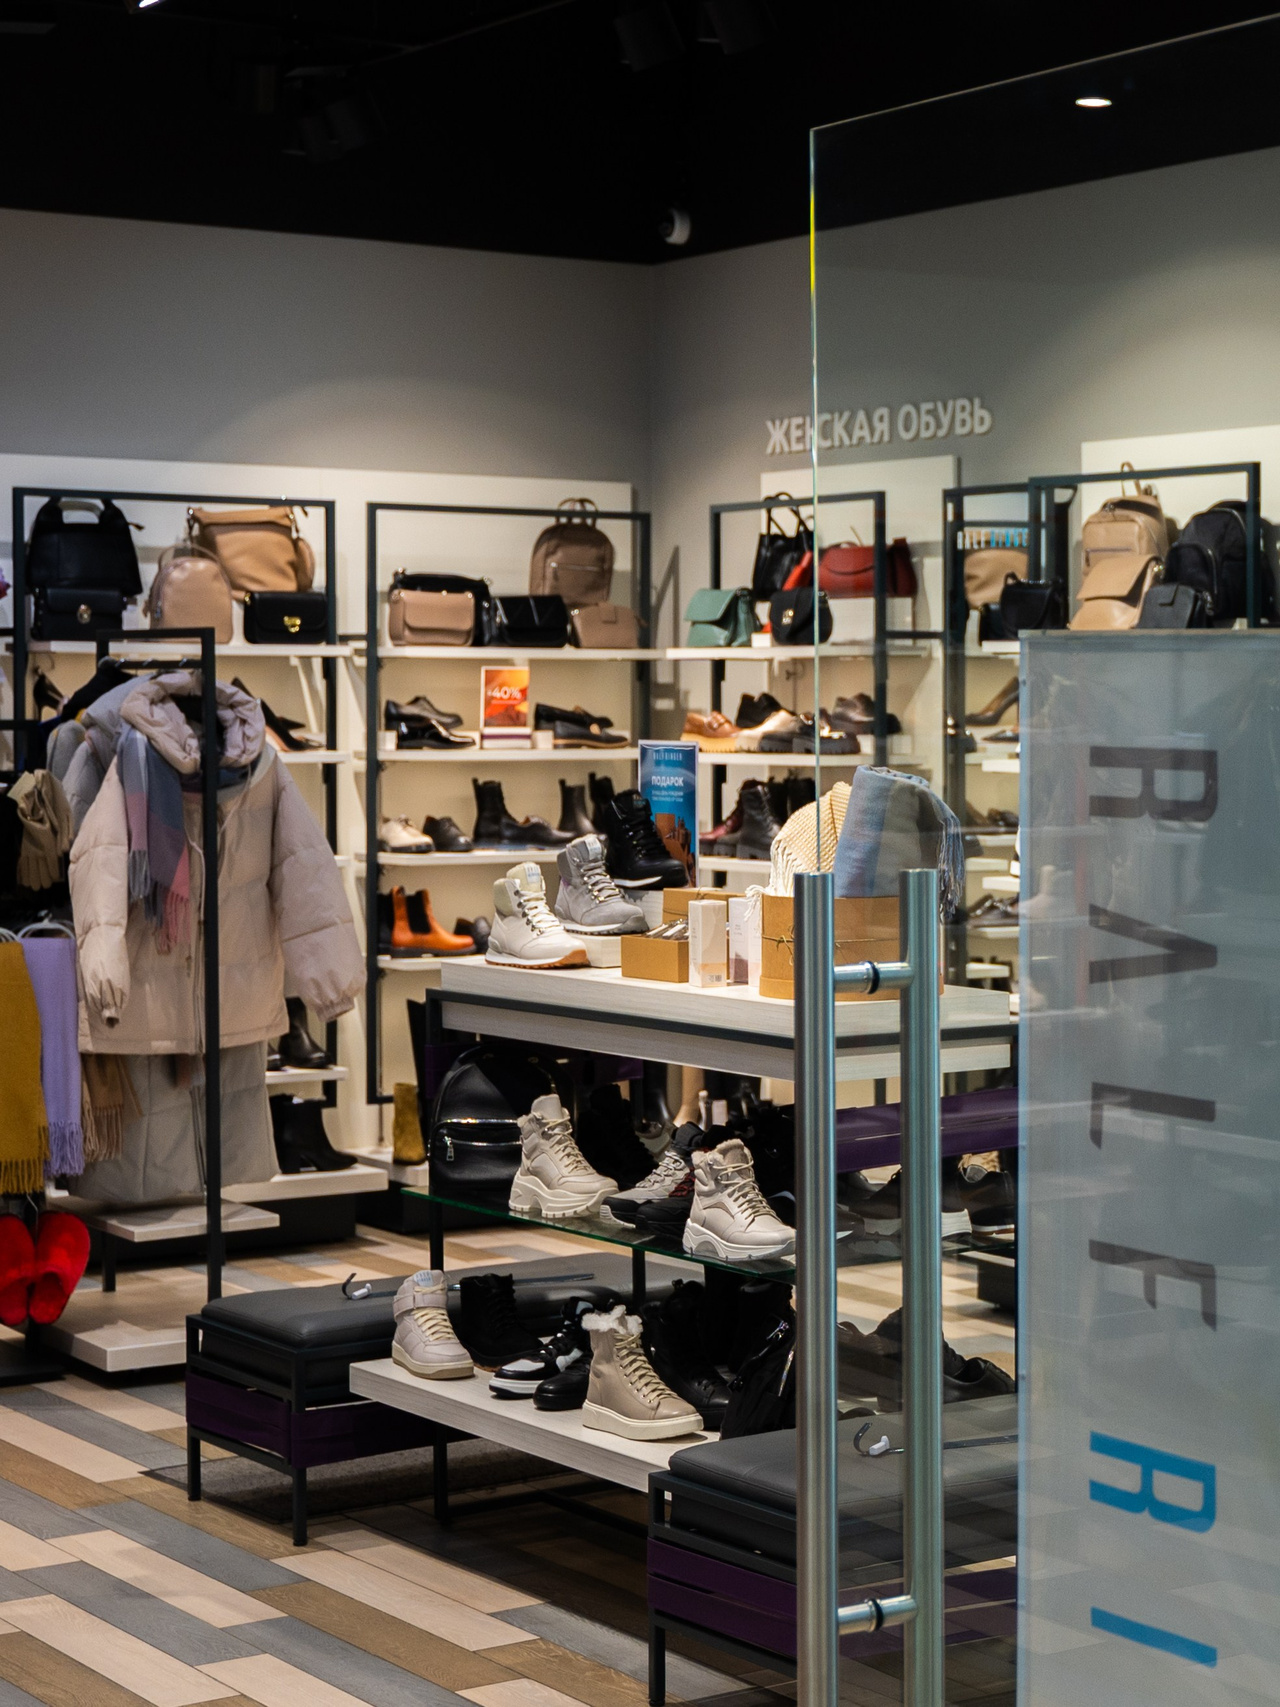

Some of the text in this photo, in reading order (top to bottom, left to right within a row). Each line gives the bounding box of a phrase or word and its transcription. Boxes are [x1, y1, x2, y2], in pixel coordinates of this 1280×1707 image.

[897, 397, 993, 442] ОБУВЬ
[487, 686, 523, 701] -40%
[651, 775, 684, 787] ПОДАРОК
